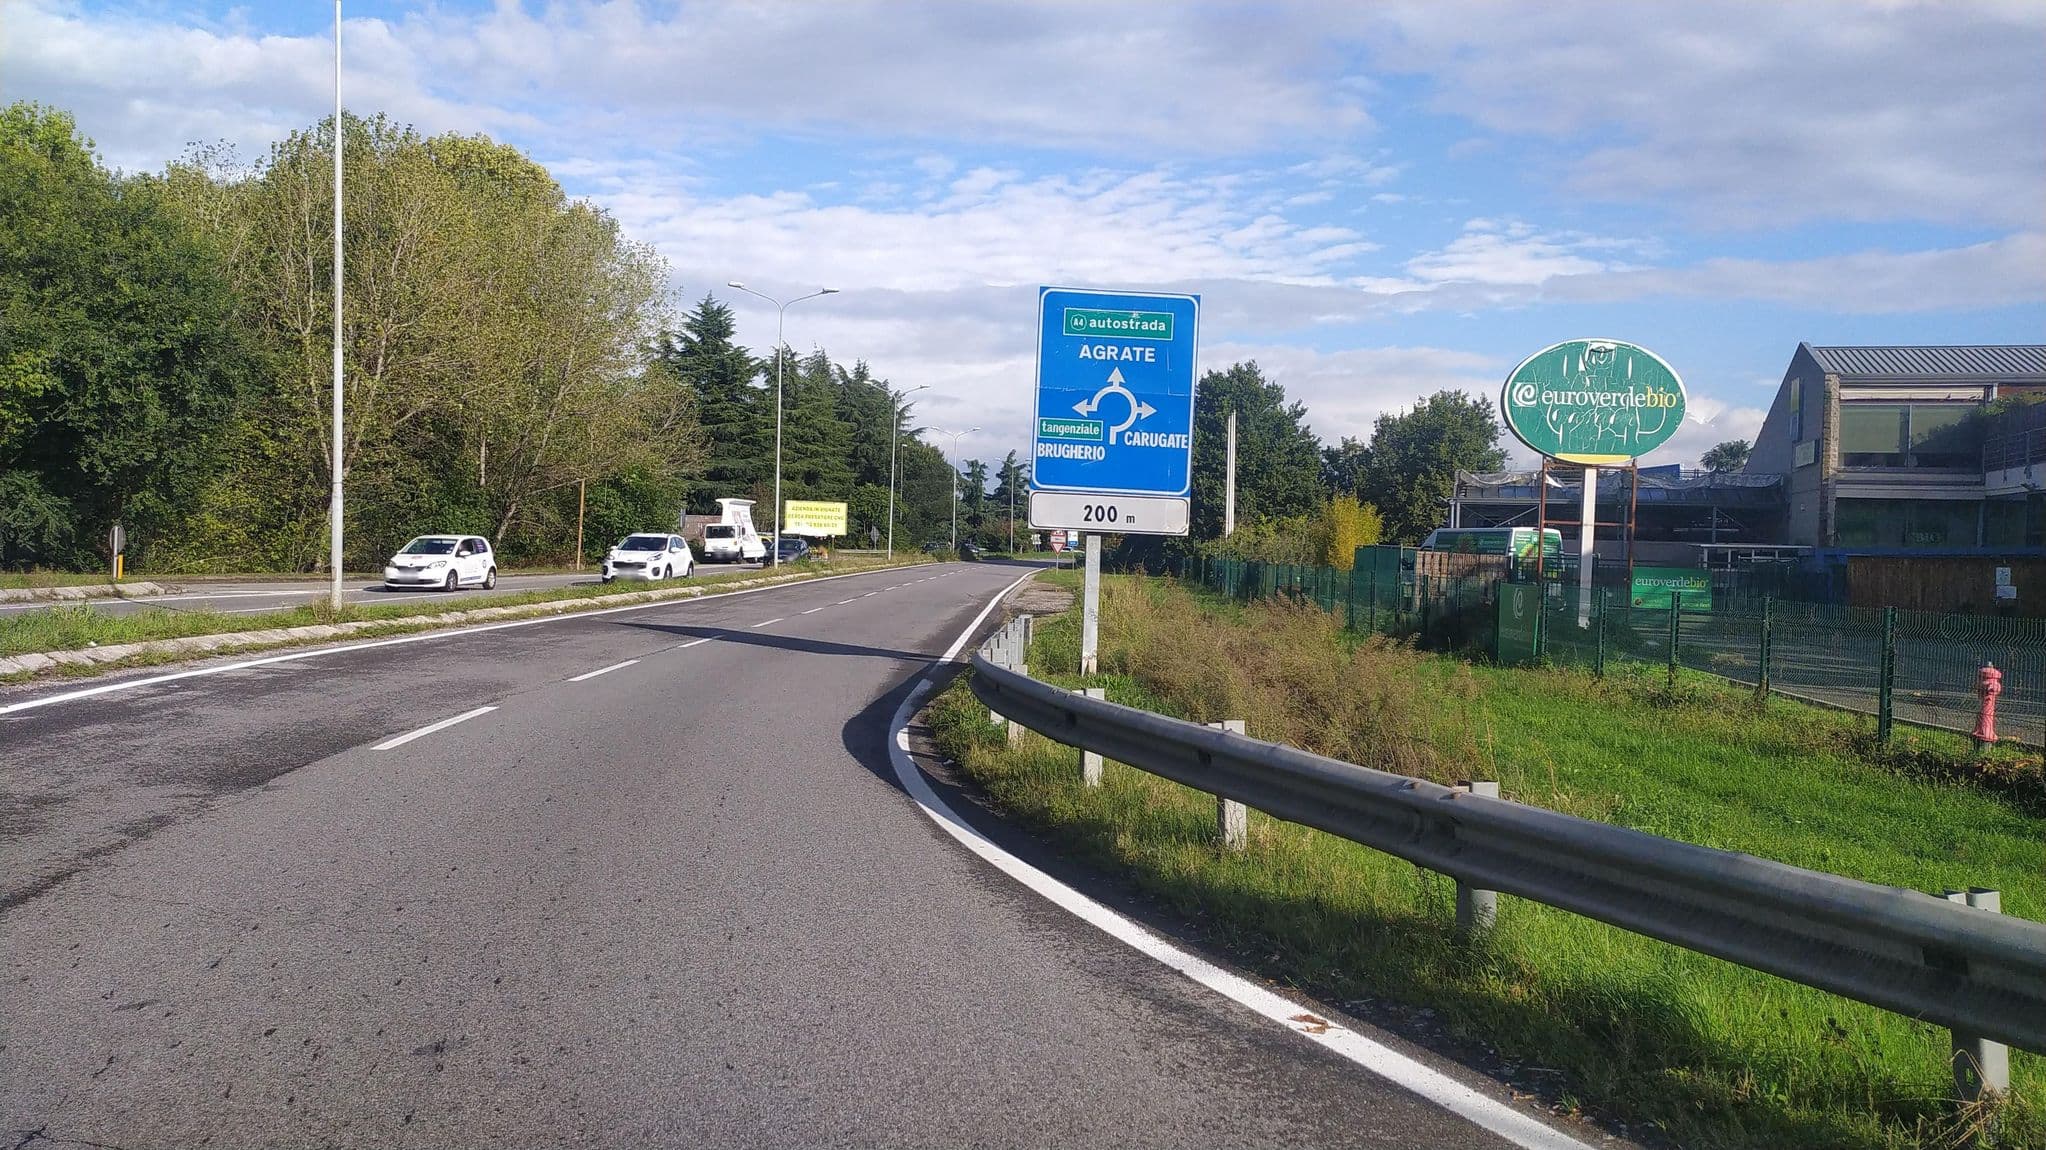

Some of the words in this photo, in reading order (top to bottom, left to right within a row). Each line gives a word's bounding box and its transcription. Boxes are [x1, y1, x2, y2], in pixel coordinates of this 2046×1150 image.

[1073, 317, 1084, 326] A4
[1089, 317, 1166, 331] autostrada
[1079, 344, 1156, 363] AGRATE
[1541, 385, 1677, 408] euroverdebio
[1041, 420, 1100, 436] tangenziale
[1124, 431, 1188, 449] CARUGATE
[1037, 443, 1106, 461] BRUGHERIO
[1083, 505, 1118, 523] 200
[1126, 515, 1136, 524] m
[1635, 576, 1706, 588] euroverdebio
